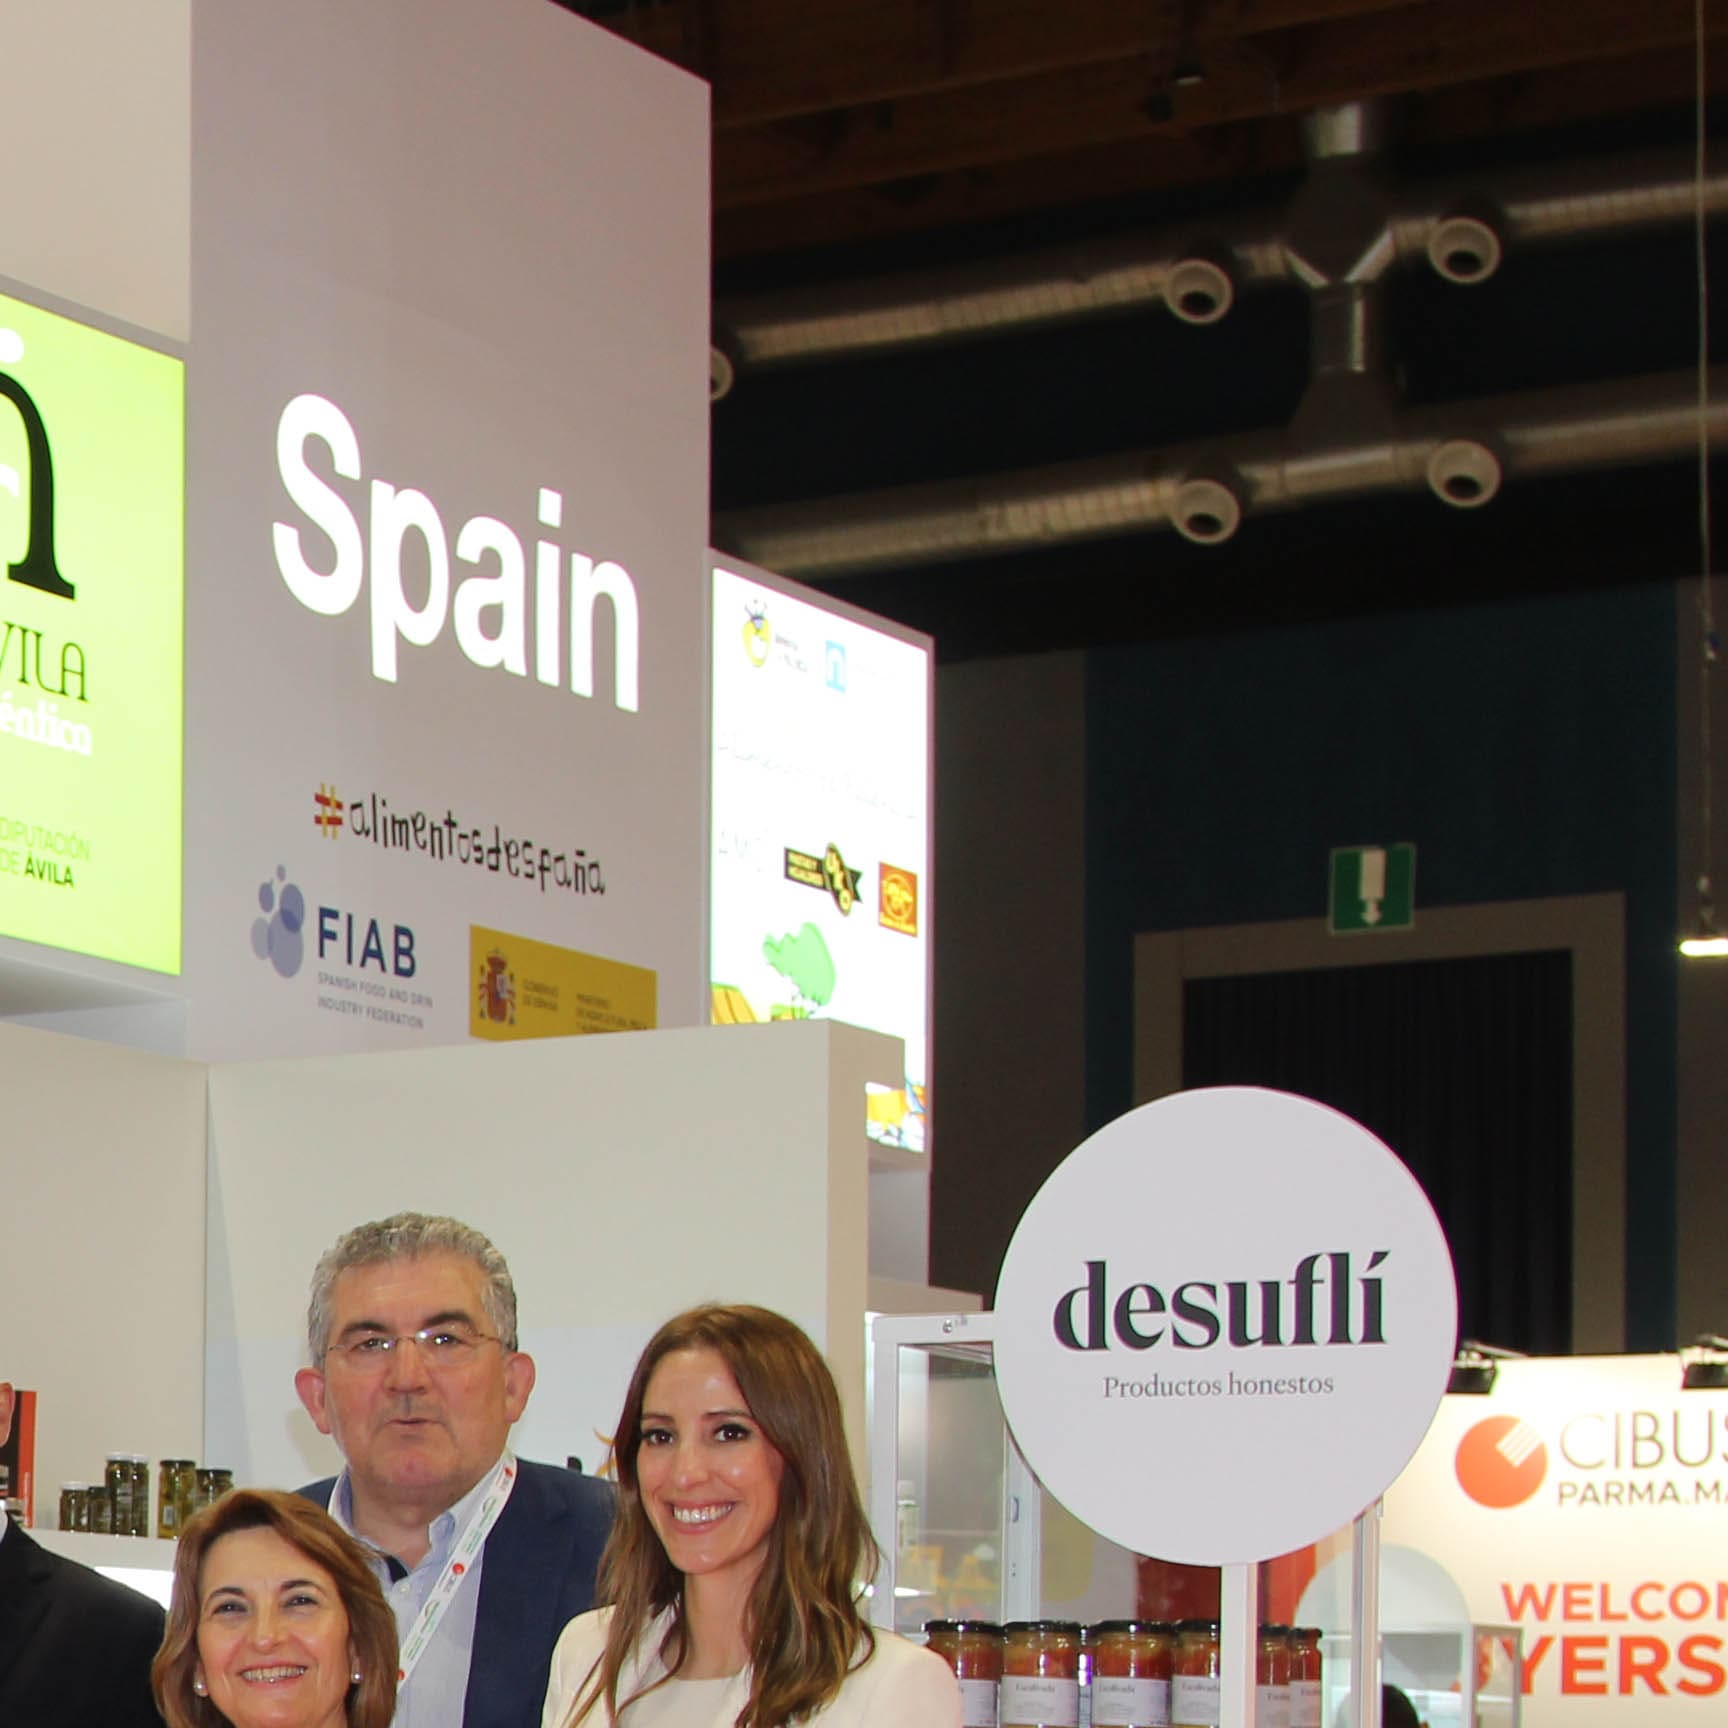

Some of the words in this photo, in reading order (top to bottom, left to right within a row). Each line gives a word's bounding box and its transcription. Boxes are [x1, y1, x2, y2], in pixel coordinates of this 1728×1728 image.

[273, 394, 640, 713] Spain
[318, 906, 418, 978] FIAB
[1052, 1249, 1392, 1352] desuflí
[1103, 1374, 1222, 1400] Productos
[1227, 1372, 1335, 1396] honestos
[1560, 1409, 1728, 1471] CIBU
[1558, 1480, 1728, 1507] PARMA.M
